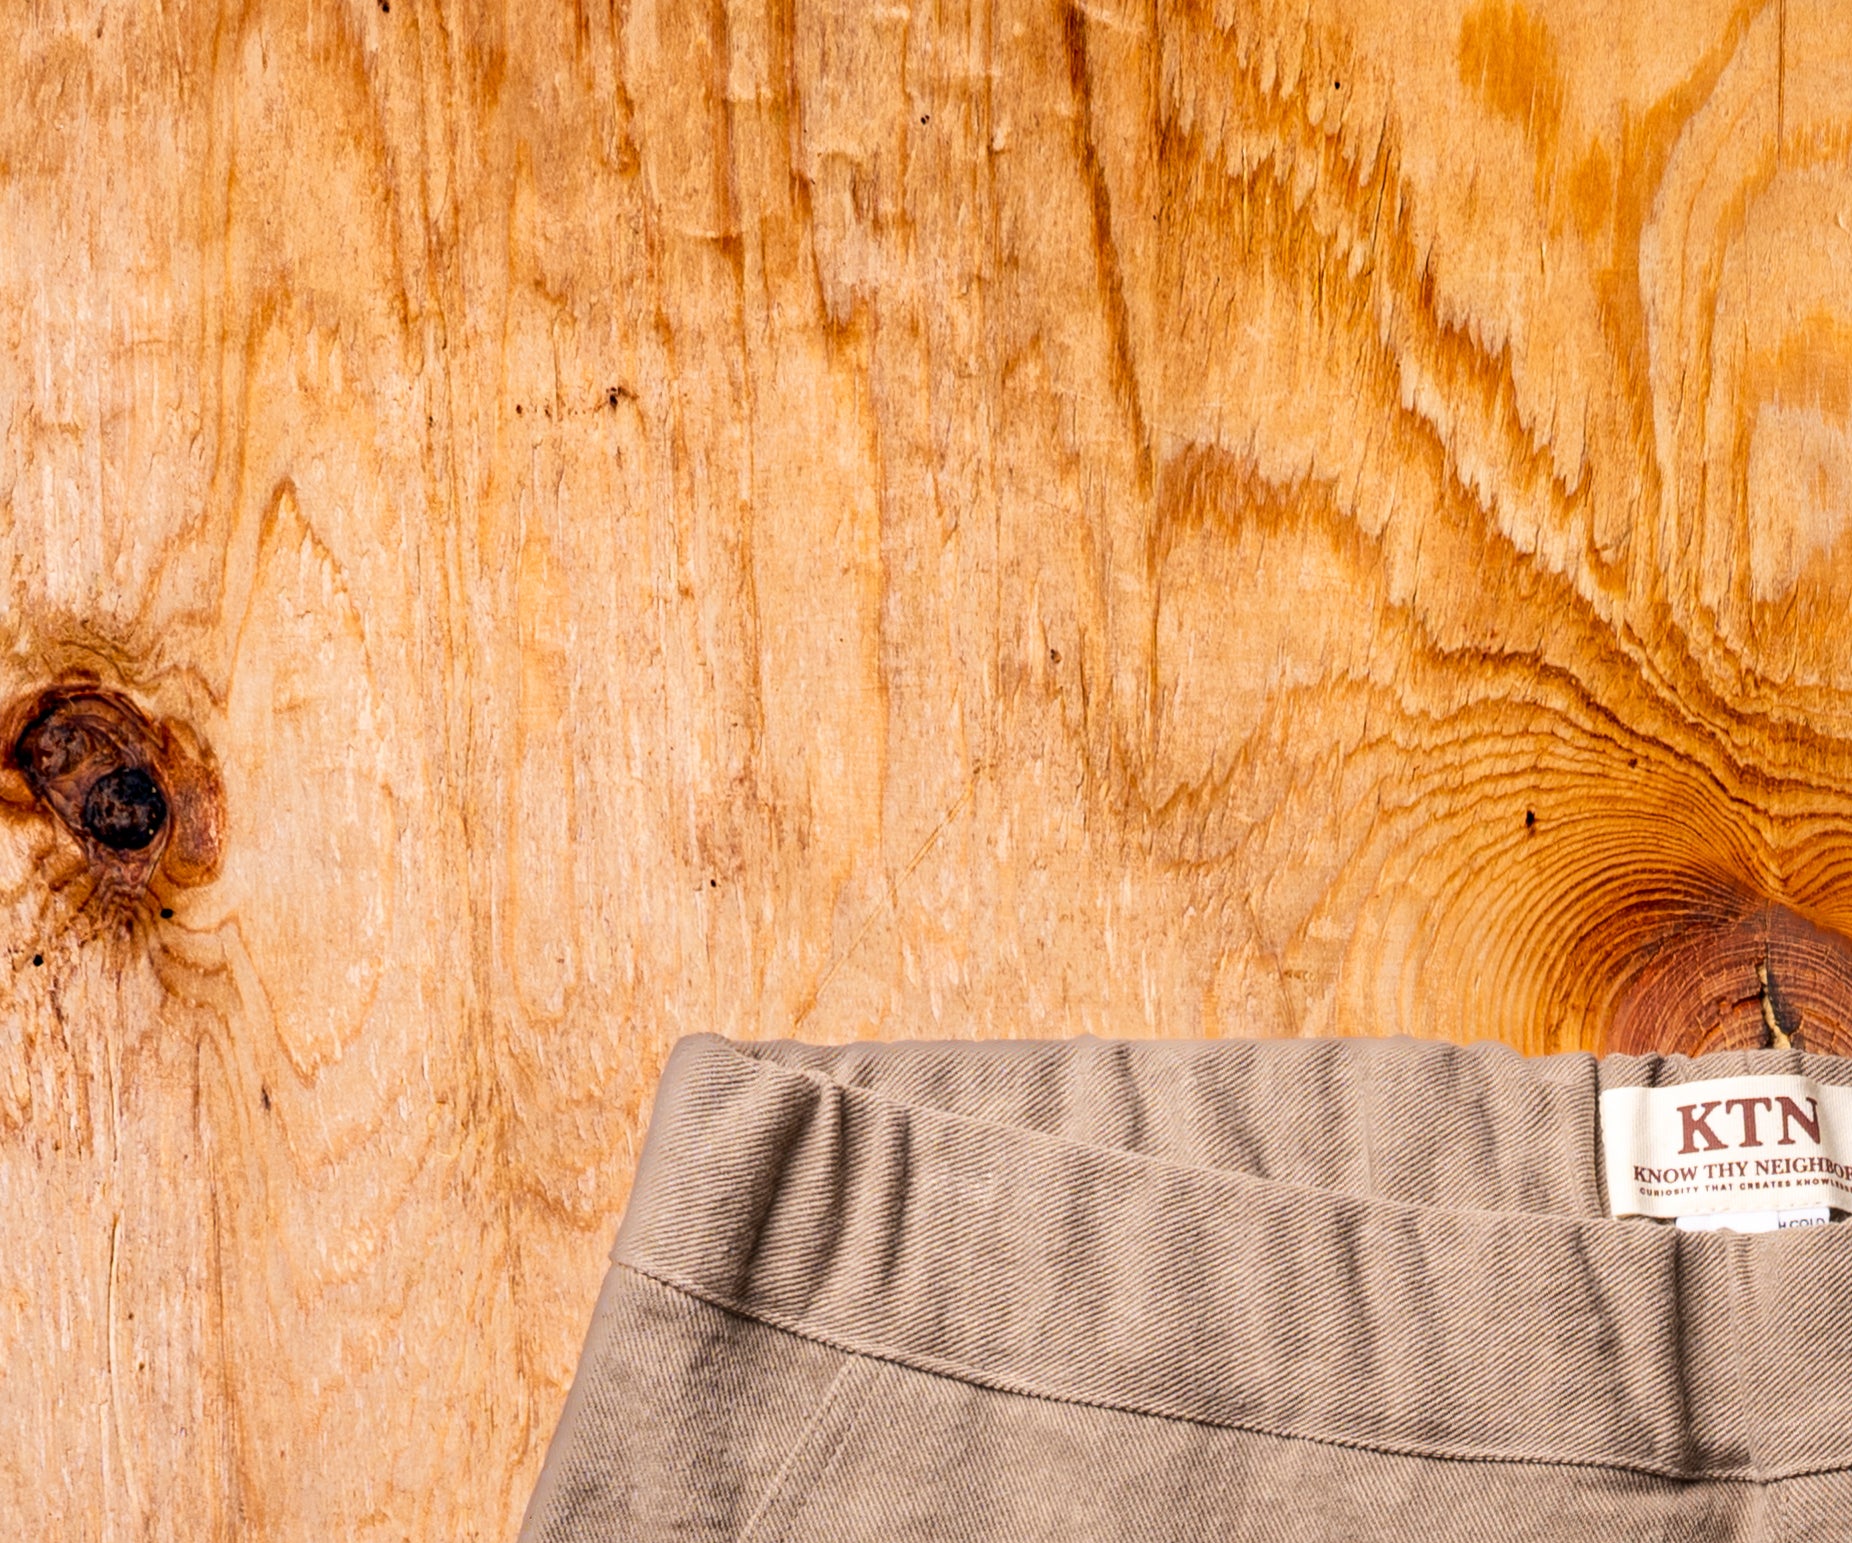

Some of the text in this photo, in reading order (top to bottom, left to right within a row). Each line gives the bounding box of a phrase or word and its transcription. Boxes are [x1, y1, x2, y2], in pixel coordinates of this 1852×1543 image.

[1676, 1096, 1821, 1155] KTN
[1633, 1165, 1698, 1183] KNOW
[1703, 1161, 1748, 1178] THY
[1640, 1187, 1699, 1197] CURIOSITY
[1705, 1183, 1733, 1192] THAT
[1740, 1180, 1791, 1191] CREATES
